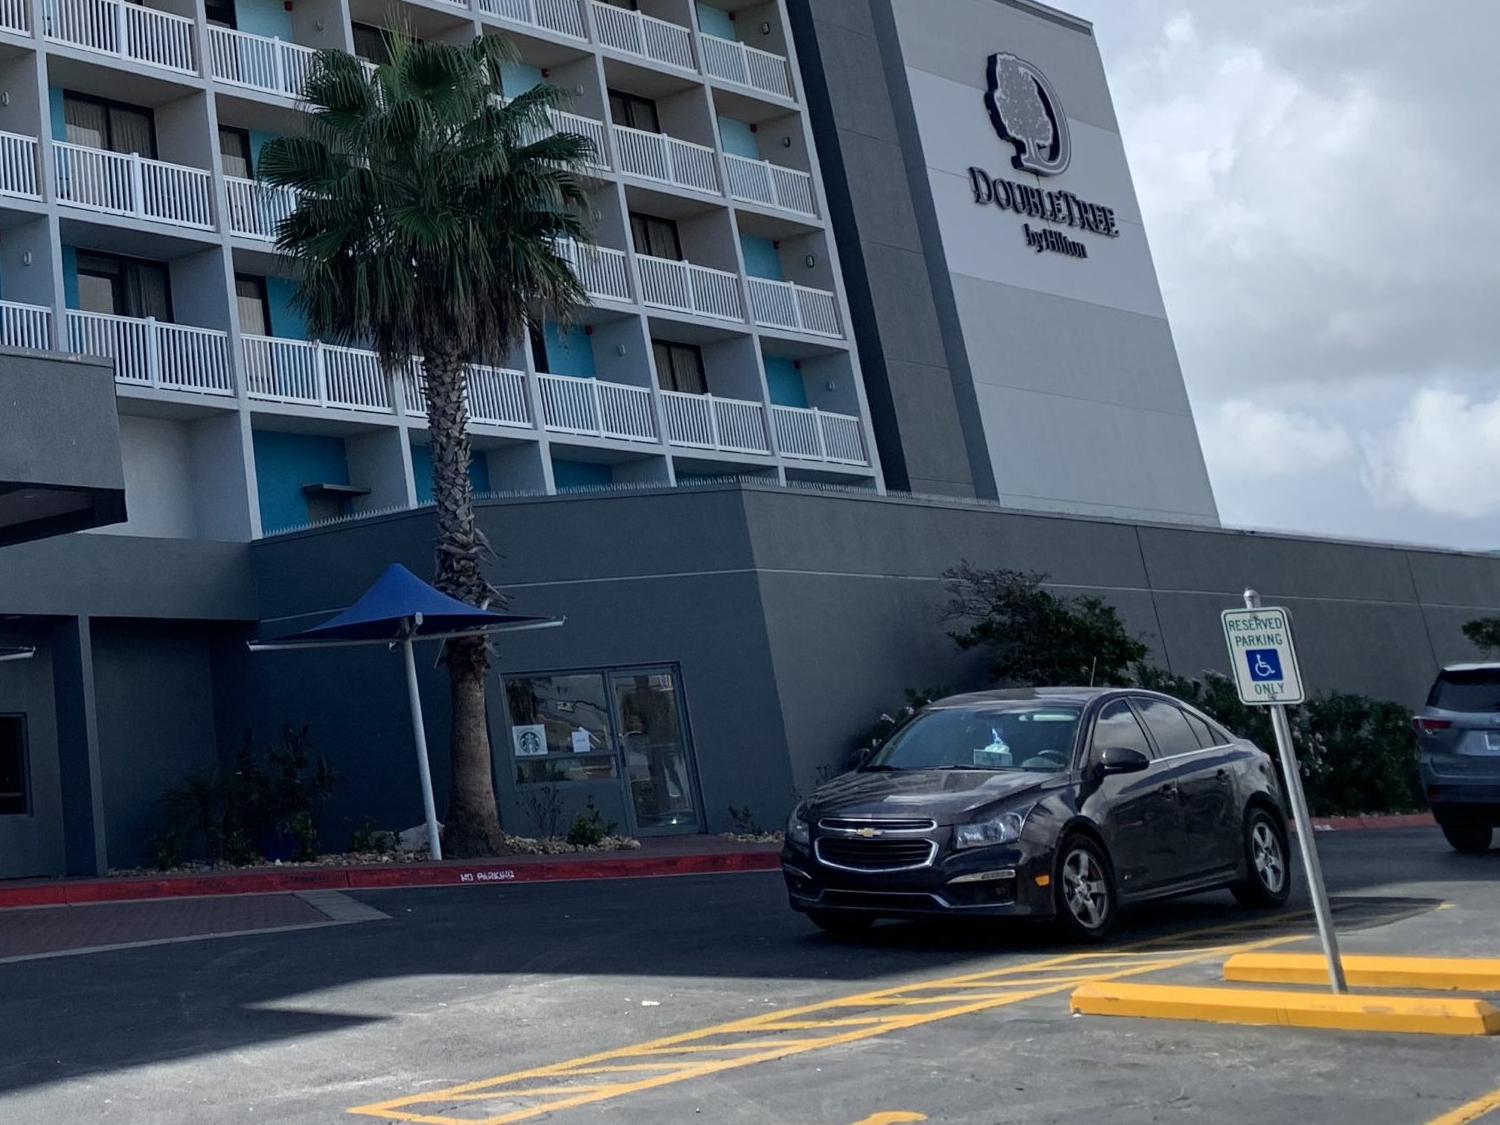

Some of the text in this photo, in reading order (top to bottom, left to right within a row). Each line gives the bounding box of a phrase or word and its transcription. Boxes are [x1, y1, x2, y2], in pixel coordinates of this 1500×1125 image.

[1022, 223, 1089, 259] by Hilton
[1228, 618, 1283, 632] RESERVED
[1235, 634, 1283, 648] PARKING
[1254, 682, 1285, 695] ONLY
[460, 870, 515, 882] NO PARKING
